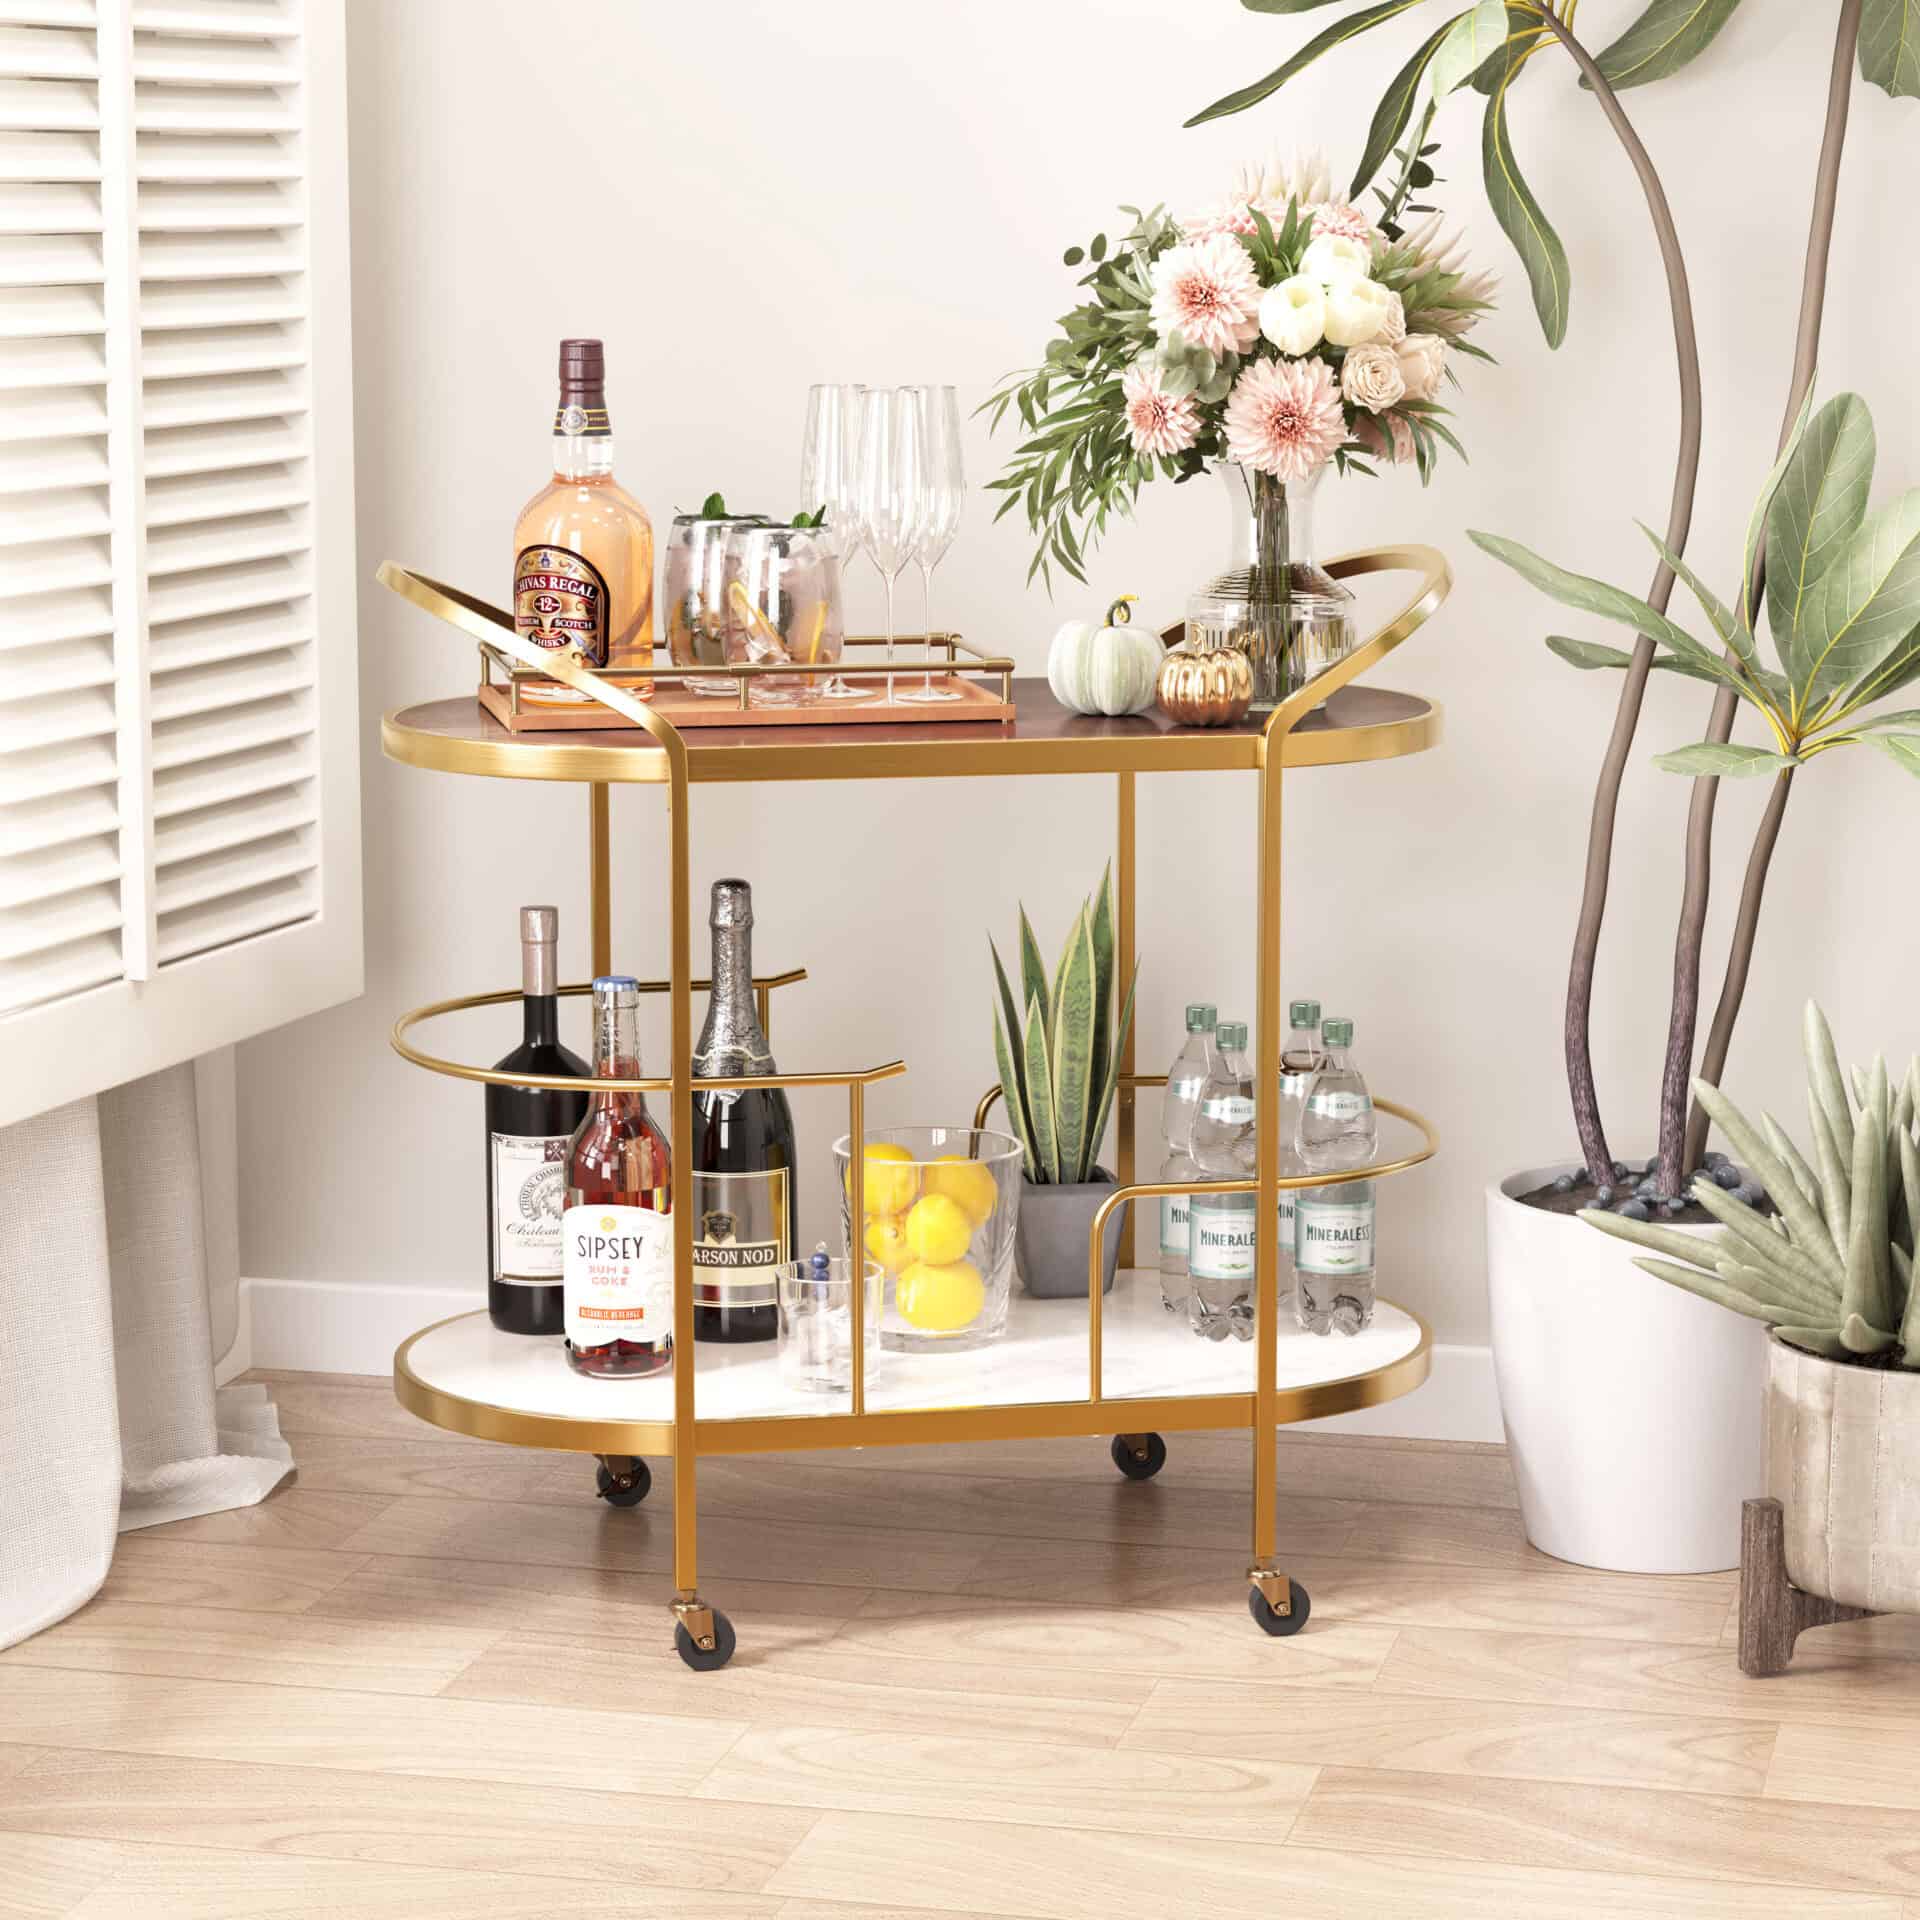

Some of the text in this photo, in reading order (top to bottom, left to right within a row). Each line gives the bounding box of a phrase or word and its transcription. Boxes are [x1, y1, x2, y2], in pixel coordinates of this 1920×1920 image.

[549, 576, 596, 599] REGAL
[555, 619, 593, 629] SCOTCH
[577, 1234, 644, 1260] SIPSEY
[742, 1248, 775, 1265] NOD
[591, 1276, 628, 1287] COKE
